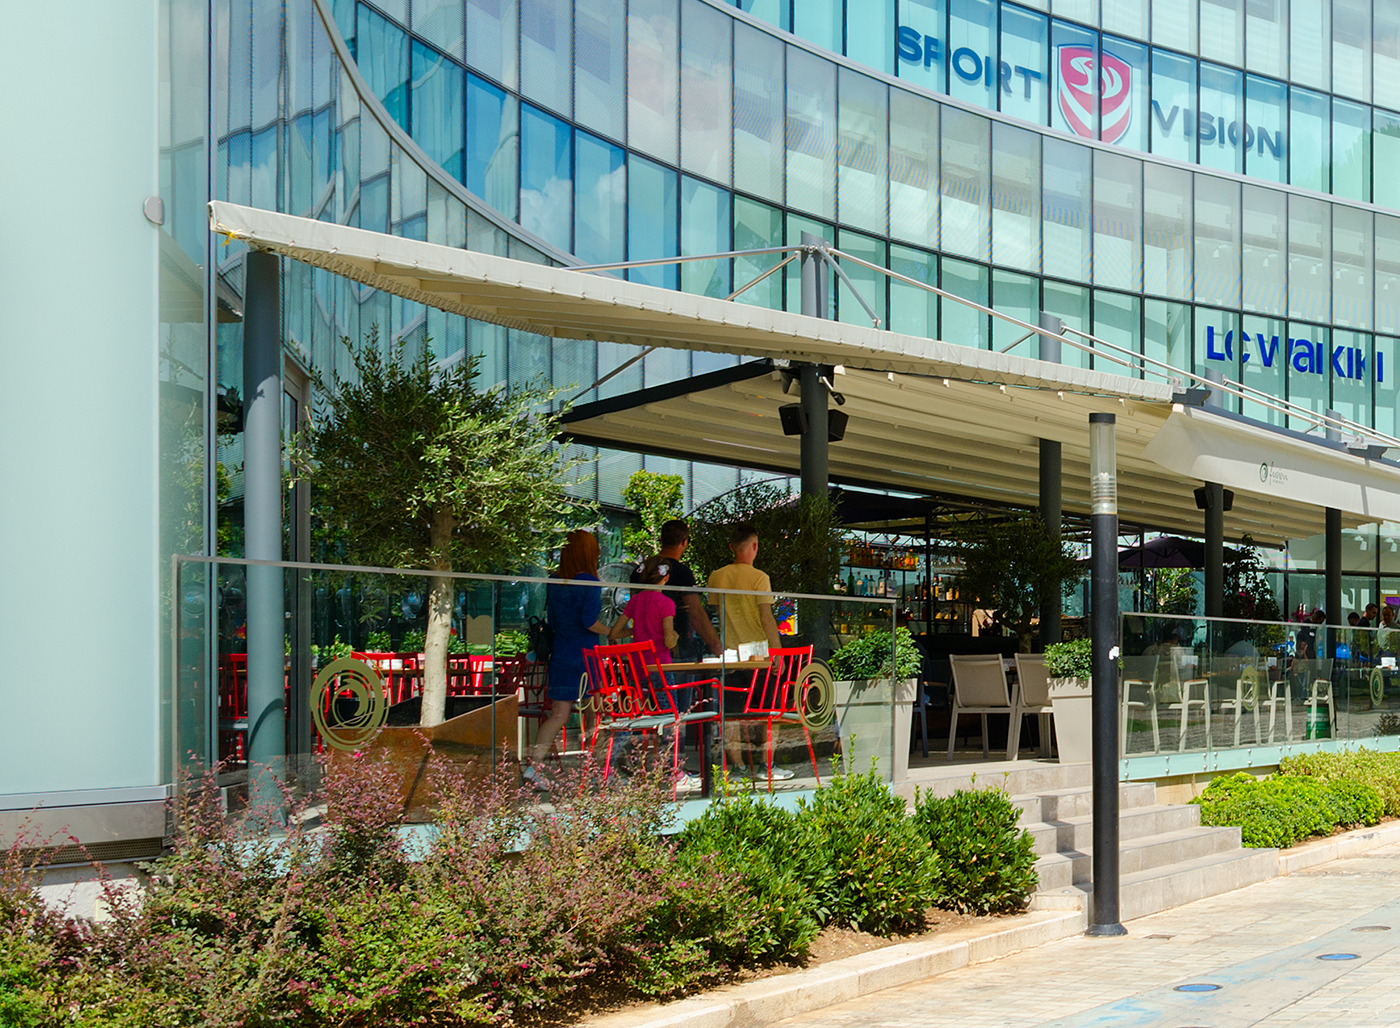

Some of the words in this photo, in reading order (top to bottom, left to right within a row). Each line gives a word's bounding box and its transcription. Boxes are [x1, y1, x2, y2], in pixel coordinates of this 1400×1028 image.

[897, 25, 1042, 99] SPORT
[1151, 99, 1282, 160] VISION
[1206, 325, 1251, 364] LC
[574, 671, 658, 734] fusion
